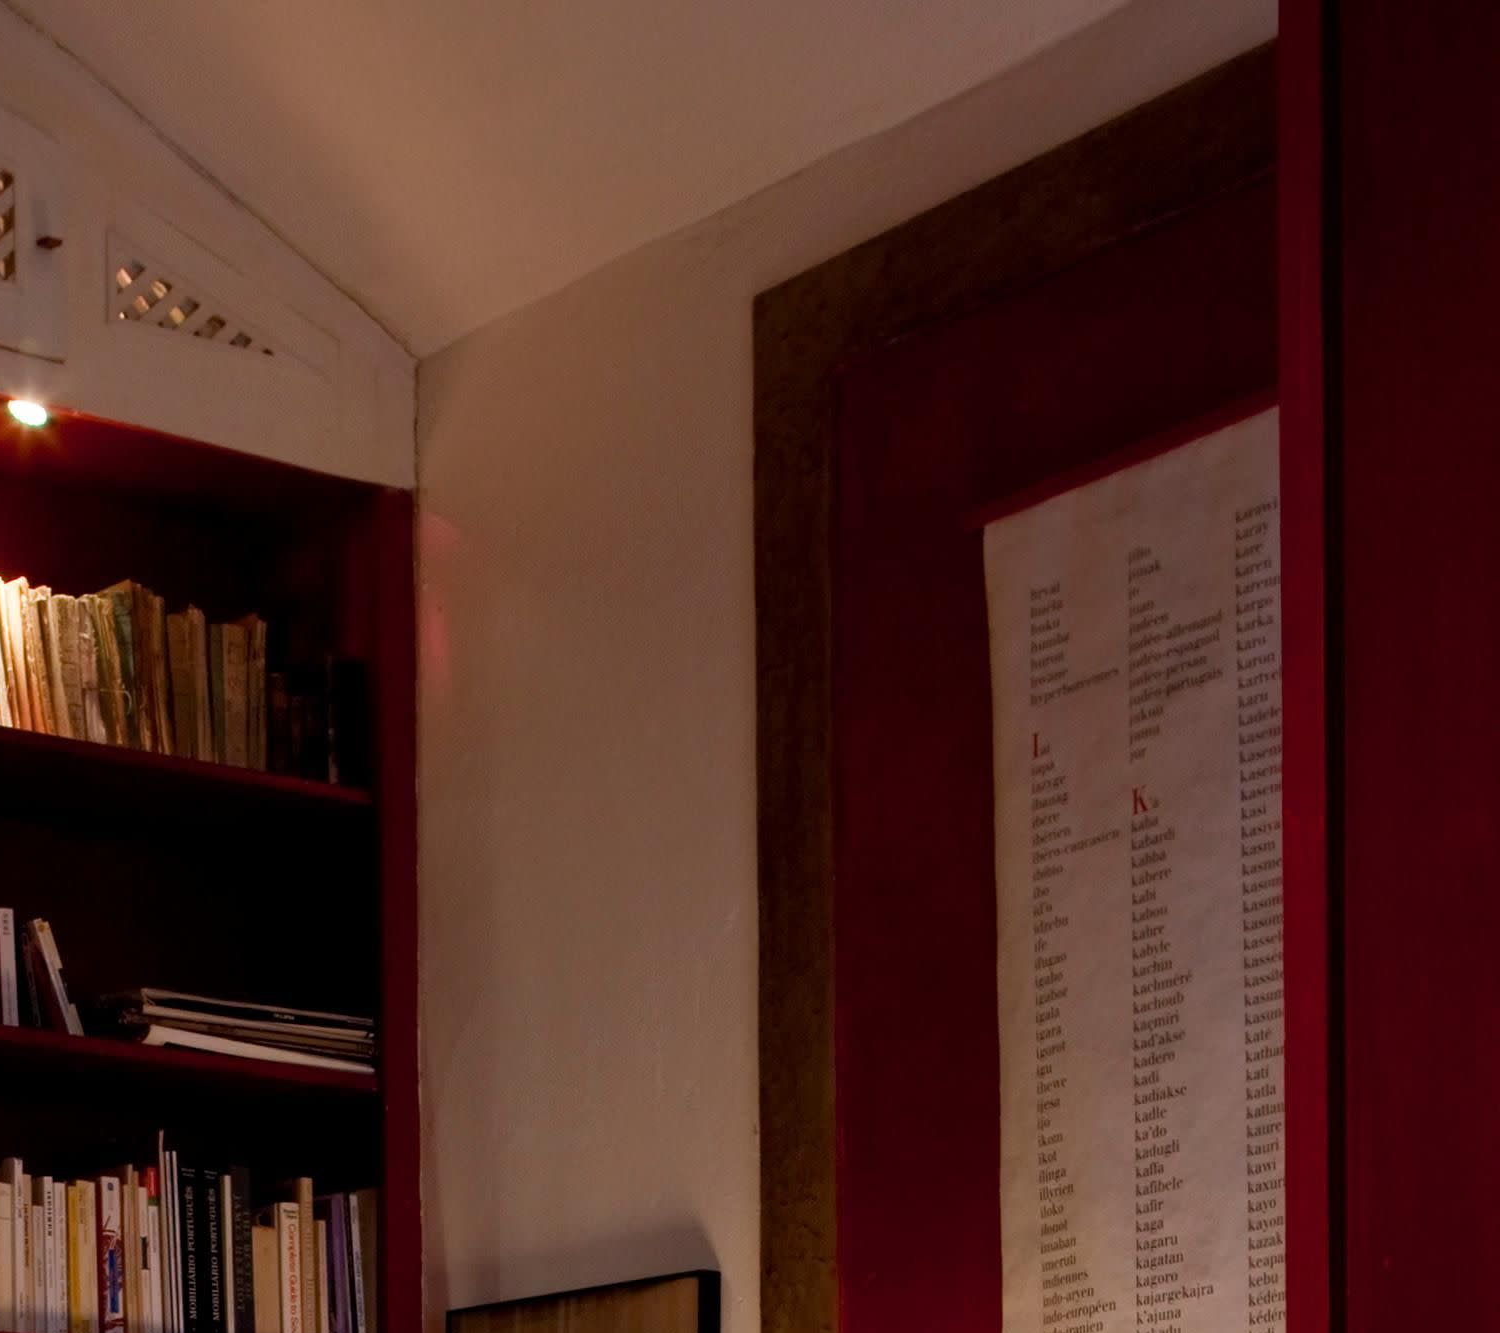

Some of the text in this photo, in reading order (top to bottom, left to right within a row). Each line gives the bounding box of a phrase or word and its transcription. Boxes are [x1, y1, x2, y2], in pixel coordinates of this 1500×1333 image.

[1132, 991, 1185, 1015] kachoub
[1246, 1139, 1280, 1158] kauri
[1246, 1158, 1276, 1176] kawi
[1136, 1235, 1178, 1252] kagaru
[1136, 1253, 1184, 1271] kagatan
[1136, 1272, 1178, 1289] kagoro
[291, 1305, 300, 1315] to
[1042, 1300, 1117, 1325] indo-européen
